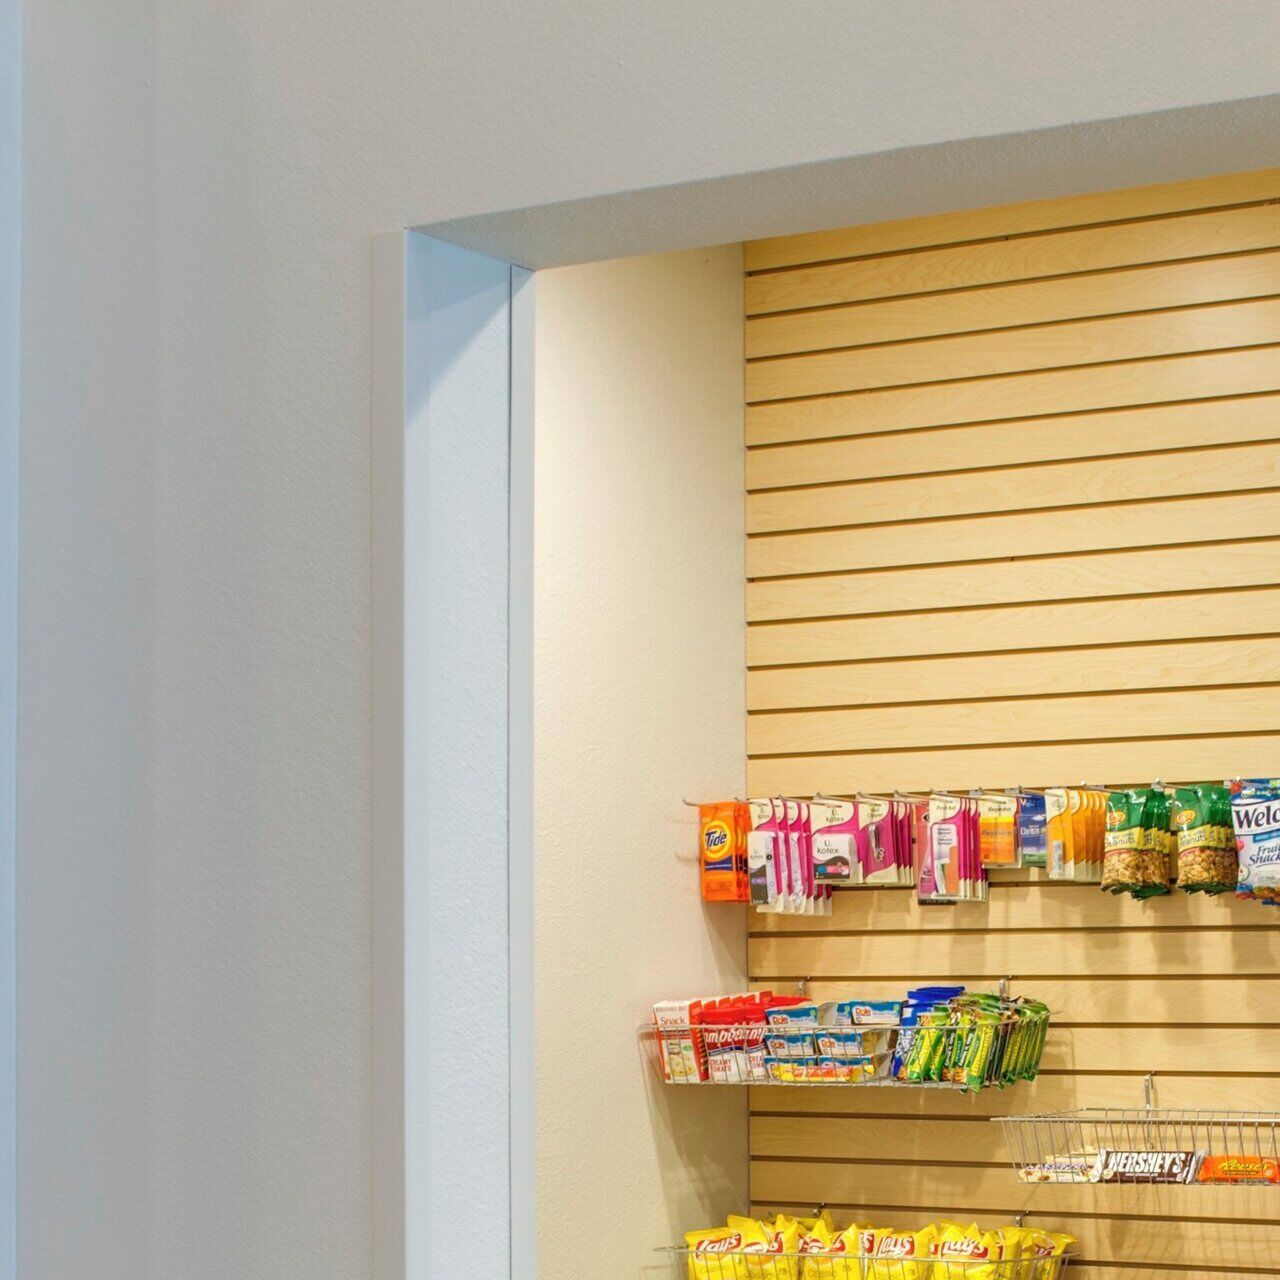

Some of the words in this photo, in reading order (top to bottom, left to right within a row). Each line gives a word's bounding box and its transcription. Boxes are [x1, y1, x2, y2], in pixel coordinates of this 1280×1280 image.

[705, 829, 728, 851] Tide
[661, 1016, 686, 1025] Snack
[1108, 1152, 1186, 1174] HERSHEY'S
